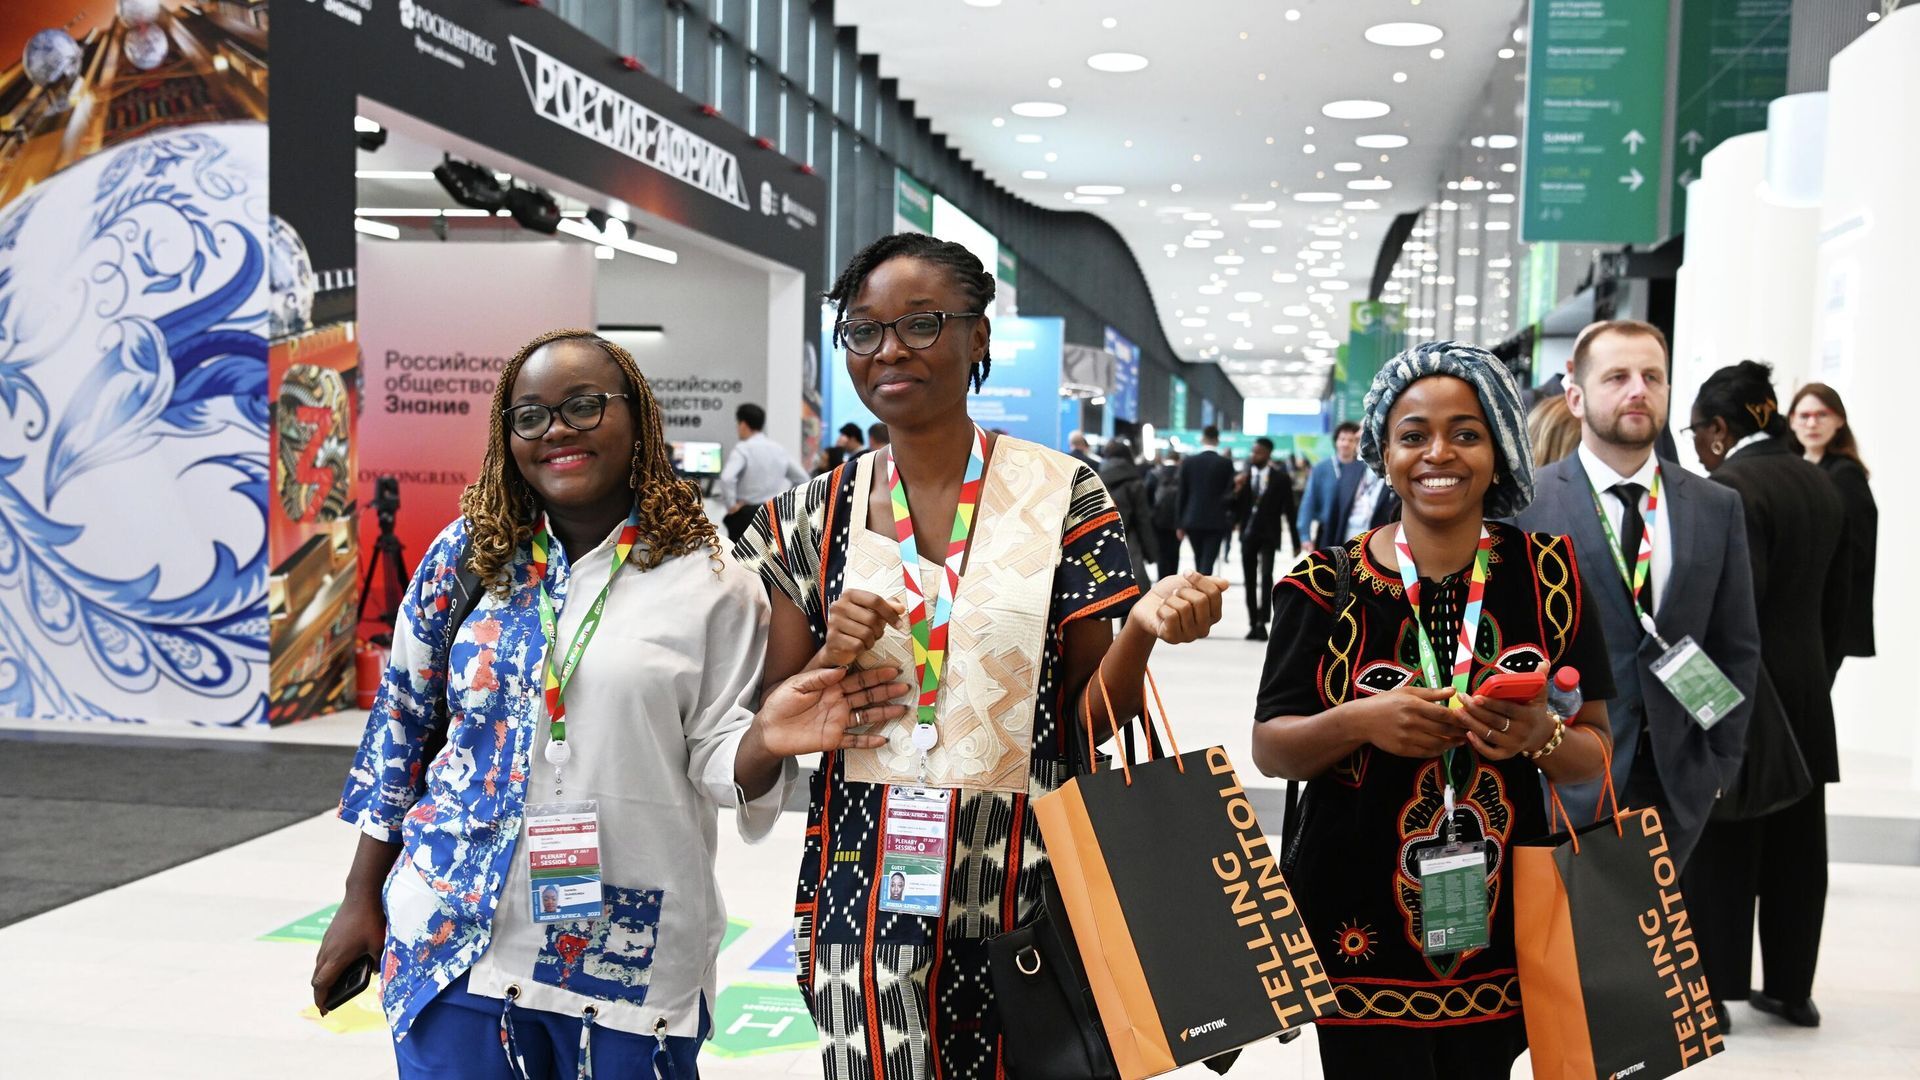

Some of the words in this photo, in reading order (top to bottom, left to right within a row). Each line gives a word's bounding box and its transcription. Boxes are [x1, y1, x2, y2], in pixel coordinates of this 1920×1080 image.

[385, 350, 505, 373] Российско
[385, 373, 495, 396] общество
[650, 375, 743, 394] ссийское
[385, 394, 470, 416] Знание
[666, 414, 702, 428] ние
[358, 468, 467, 486] OSONGRESS
[1206, 746, 1296, 920] UNTOLD
[540, 853, 567, 861] PLENARY
[540, 859, 567, 867] SESSION
[1640, 807, 1700, 970] UNTOLD
[1212, 851, 1304, 1029] TELLING
[1281, 926, 1337, 1017] THE
[1638, 908, 1700, 1069] TELLING
[725, 1013, 795, 1038] H
[1189, 1017, 1228, 1038] SPUTNIK
[1687, 975, 1724, 1057] THE
[1616, 1061, 1646, 1079] SPUTNIK
